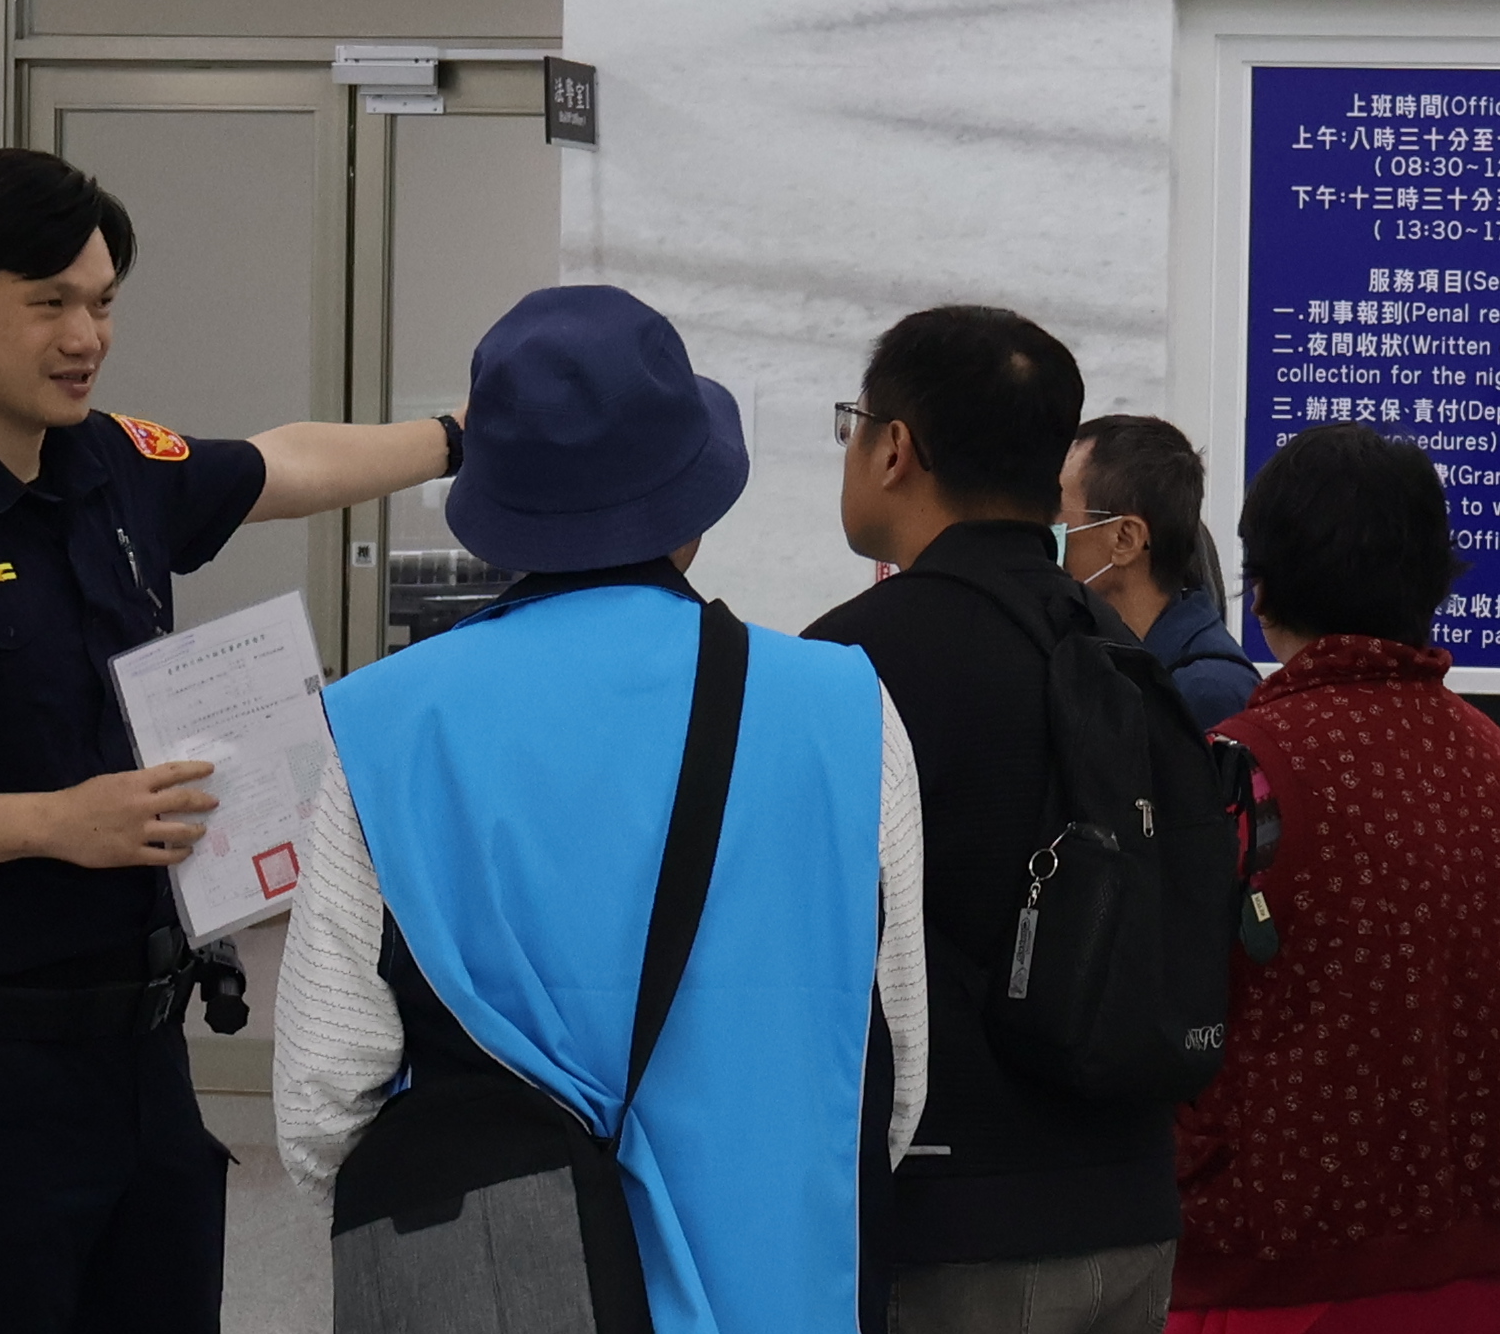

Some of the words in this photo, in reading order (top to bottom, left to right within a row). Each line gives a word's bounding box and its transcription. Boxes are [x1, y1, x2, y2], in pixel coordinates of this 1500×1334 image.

[1277, 363, 1381, 384] collection
[1390, 364, 1422, 385] for
[1431, 365, 1467, 386] the
[1460, 496, 1483, 516] to
[1430, 622, 1473, 644] fter
